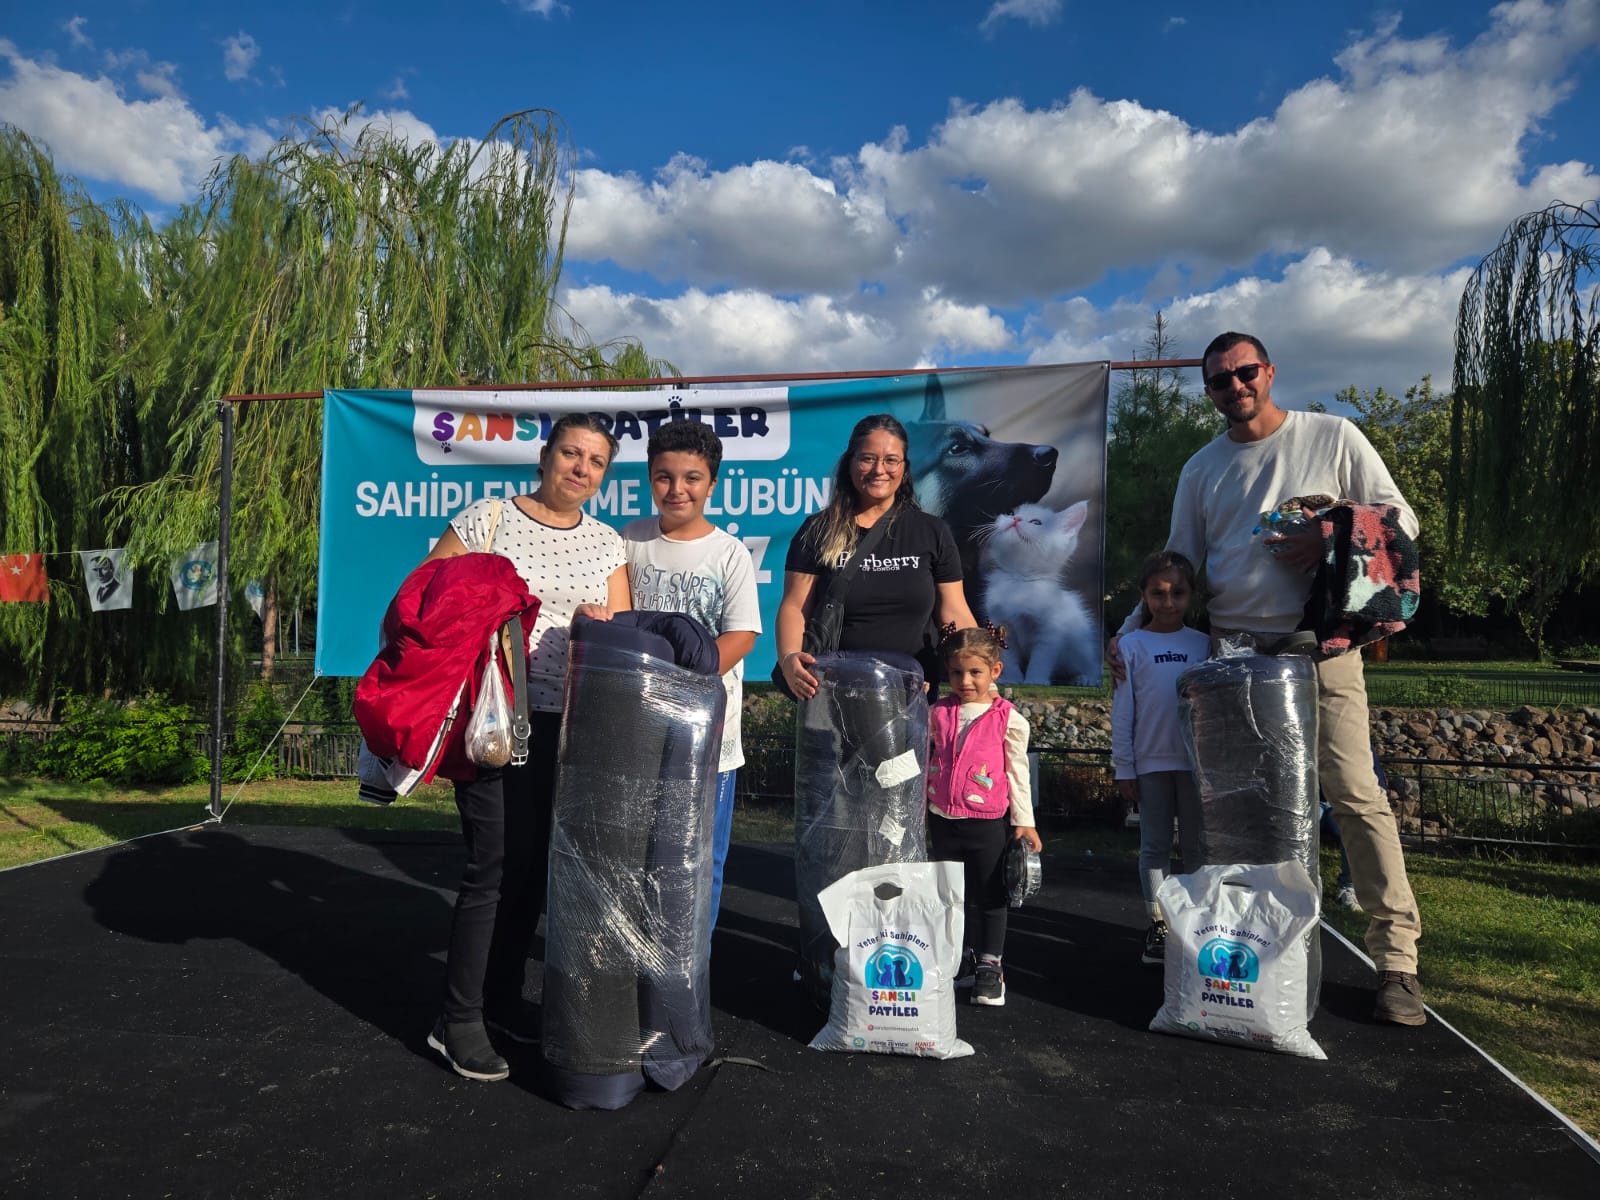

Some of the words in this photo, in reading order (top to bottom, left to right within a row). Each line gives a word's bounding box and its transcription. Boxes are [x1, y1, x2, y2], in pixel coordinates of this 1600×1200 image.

[432, 412, 553, 454] ŞANSL
[837, 550, 921, 569] rberry
[669, 570, 710, 598] SURF
[857, 935, 879, 948] Yeter
[880, 928, 889, 938] ki
[1194, 925, 1218, 937] Yeter
[1219, 924, 1228, 934] ki
[1205, 978, 1251, 993] ŞANSLI
[871, 991, 916, 1004] ŞANSLI
[1202, 992, 1254, 1009] PATİLER
[868, 1003, 919, 1017] PATİLER
